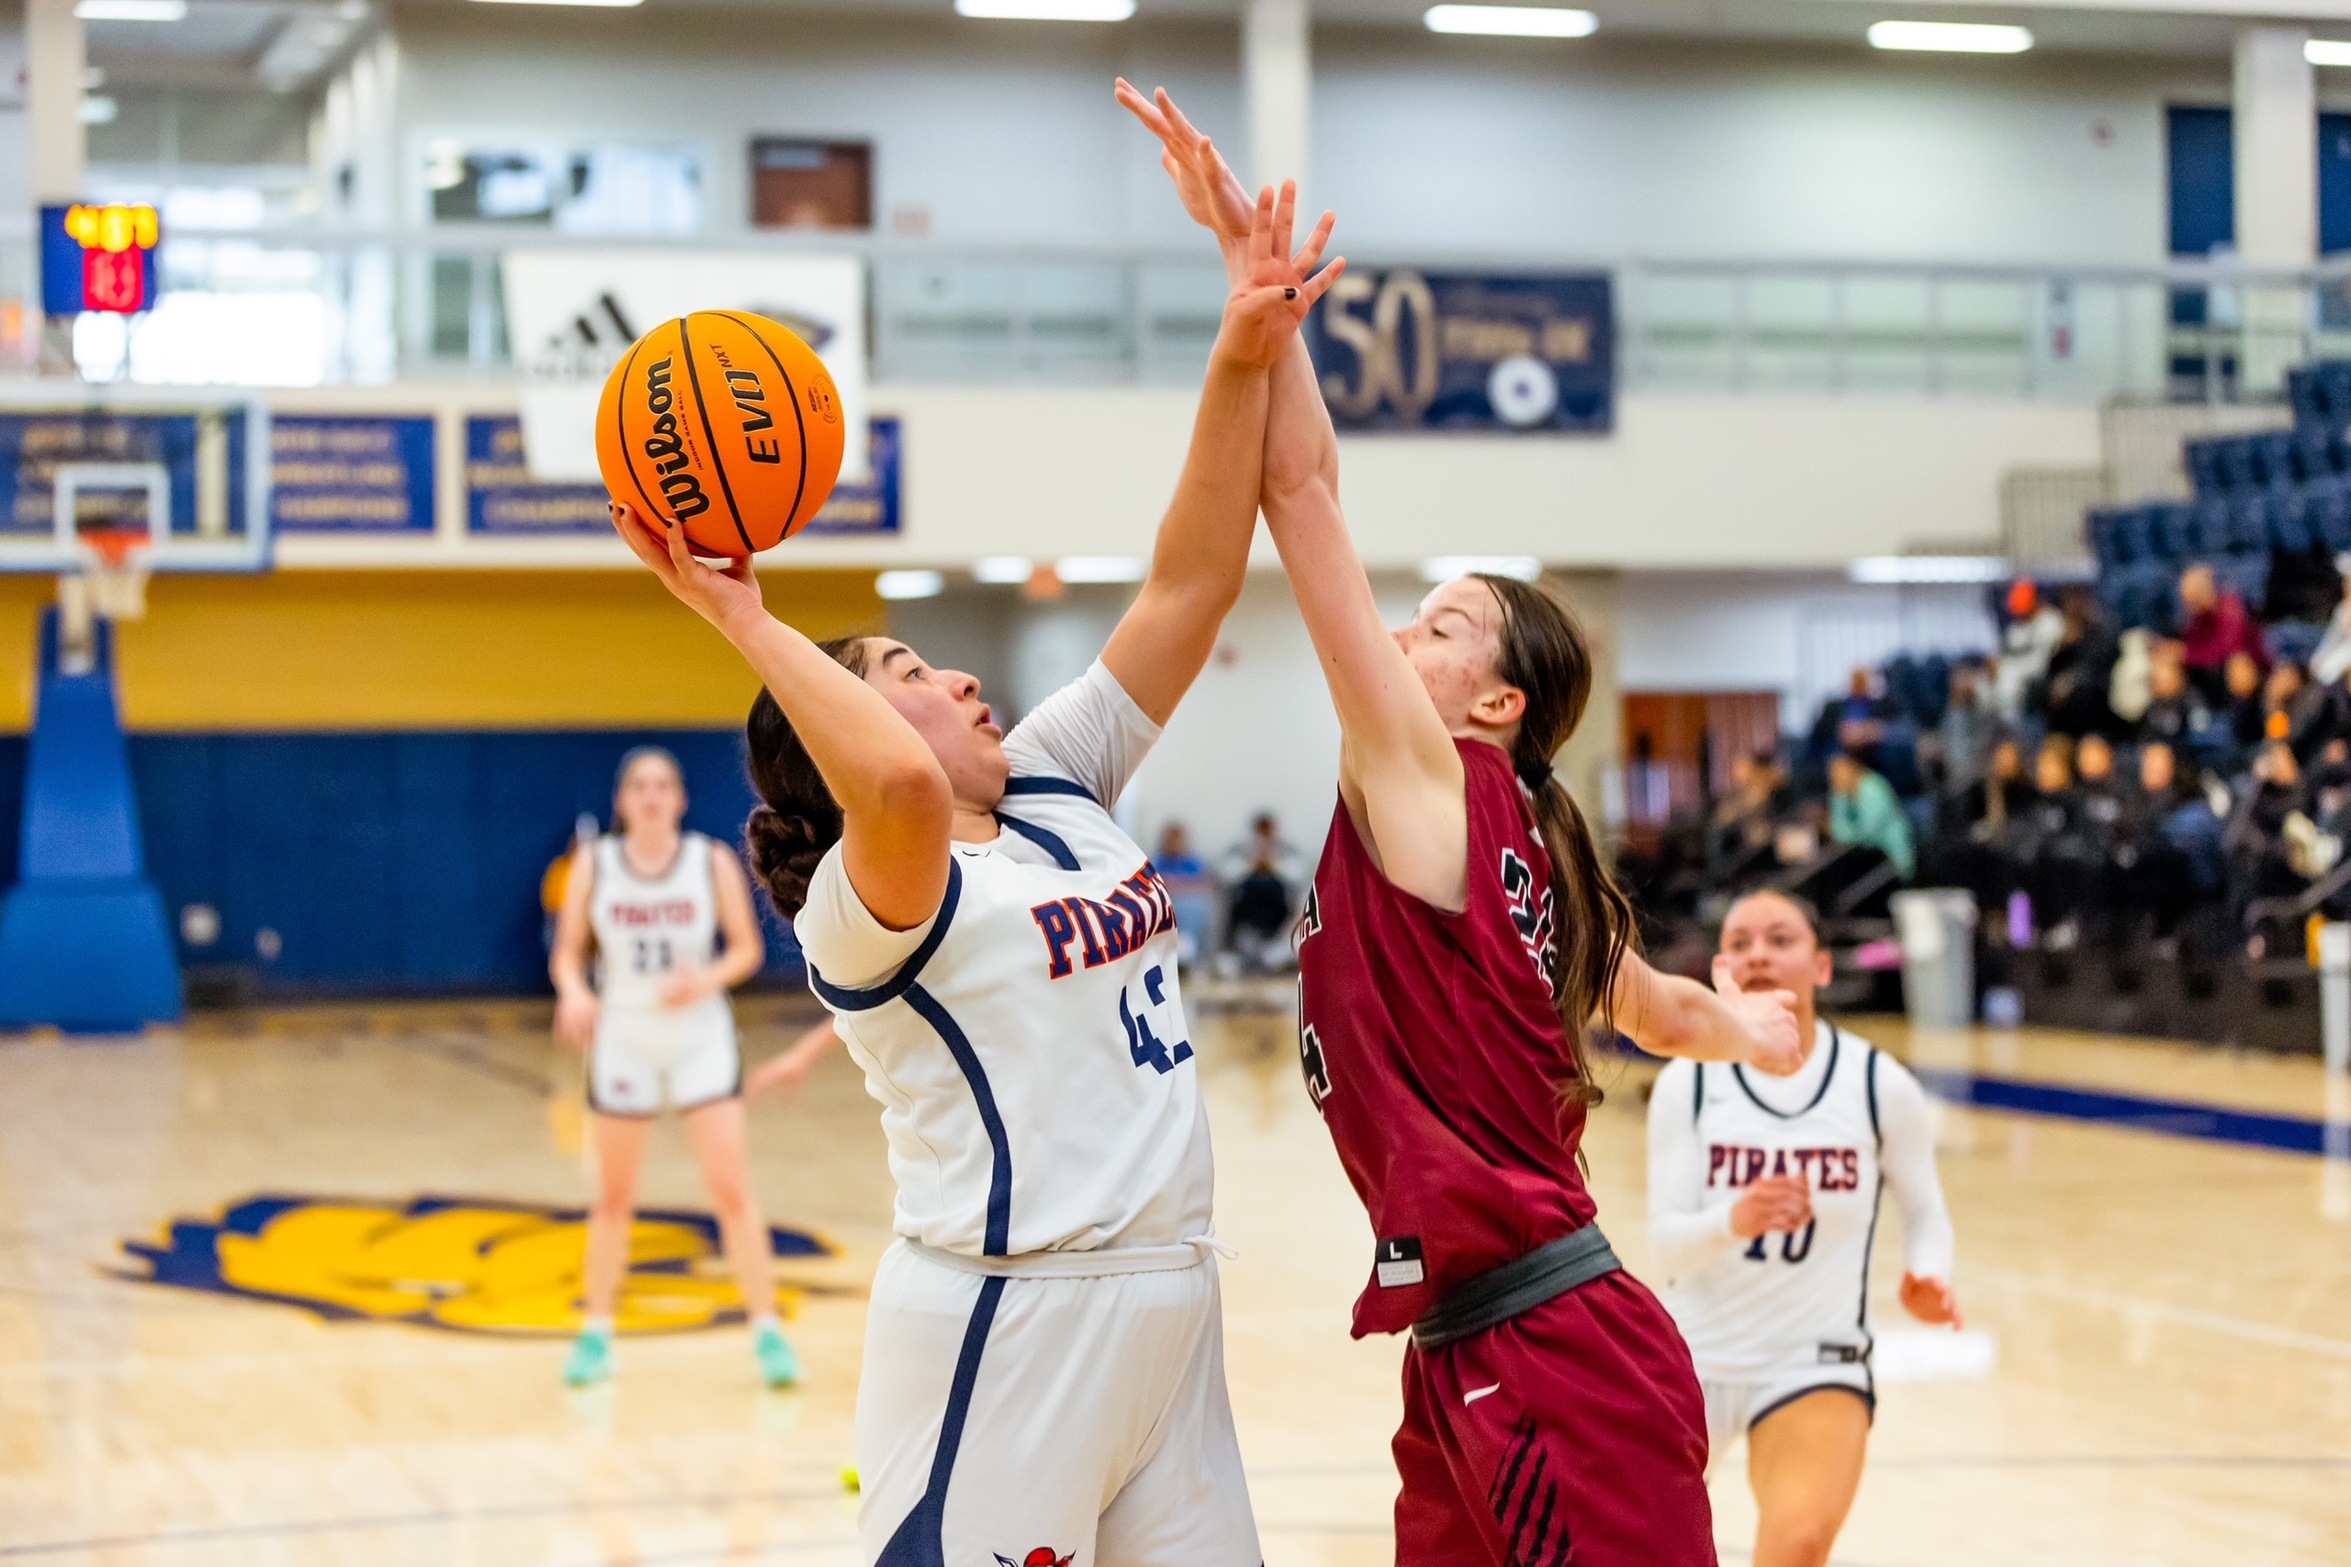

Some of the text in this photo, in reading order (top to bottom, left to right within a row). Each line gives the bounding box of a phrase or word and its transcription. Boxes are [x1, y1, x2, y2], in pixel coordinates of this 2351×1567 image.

[709, 343, 733, 368] NXT
[1322, 268, 1440, 418] 50
[644, 356, 710, 523] Wilson
[681, 413, 691, 437] GAME
[688, 440, 703, 470] INDOOR
[1707, 1144, 1859, 1191] PIRATES
[1389, 1241, 1403, 1260] L
